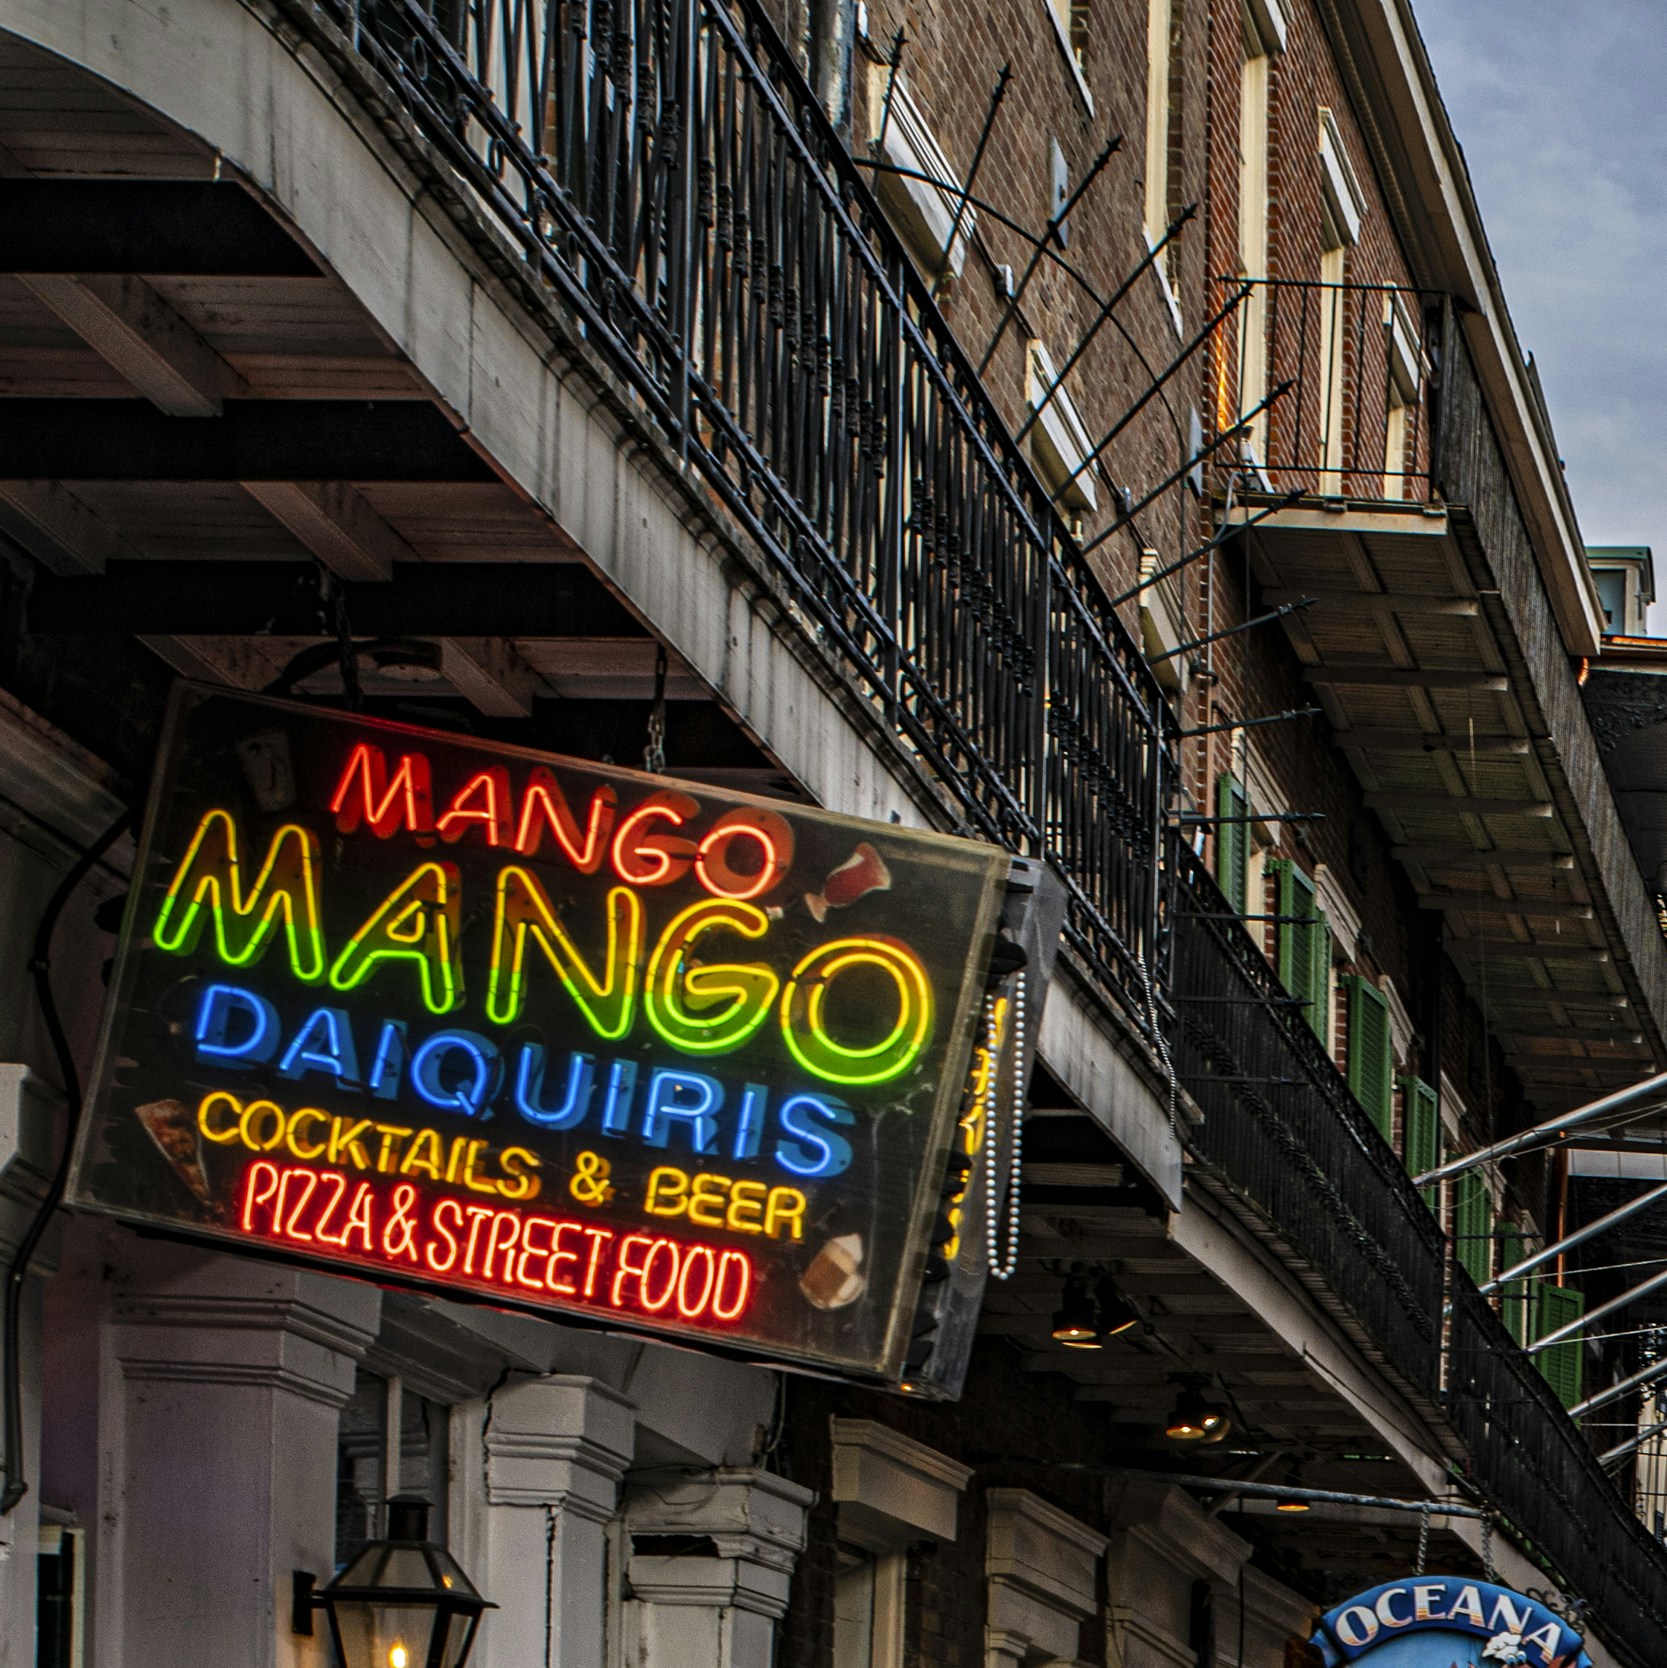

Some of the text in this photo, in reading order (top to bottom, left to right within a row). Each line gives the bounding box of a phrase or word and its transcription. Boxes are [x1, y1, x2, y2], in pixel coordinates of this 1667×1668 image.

[331, 741, 781, 901] MANGO
[153, 807, 934, 1086] MANGO
[195, 983, 850, 1176] DAIQUIRIS
[198, 1091, 806, 1243] COCKTAILS & BEER
[241, 1162, 374, 1250] PIZZA
[426, 1199, 606, 1297] STREET
[616, 1233, 752, 1322] FOOD
[1335, 1584, 1562, 1664] OCEANA
